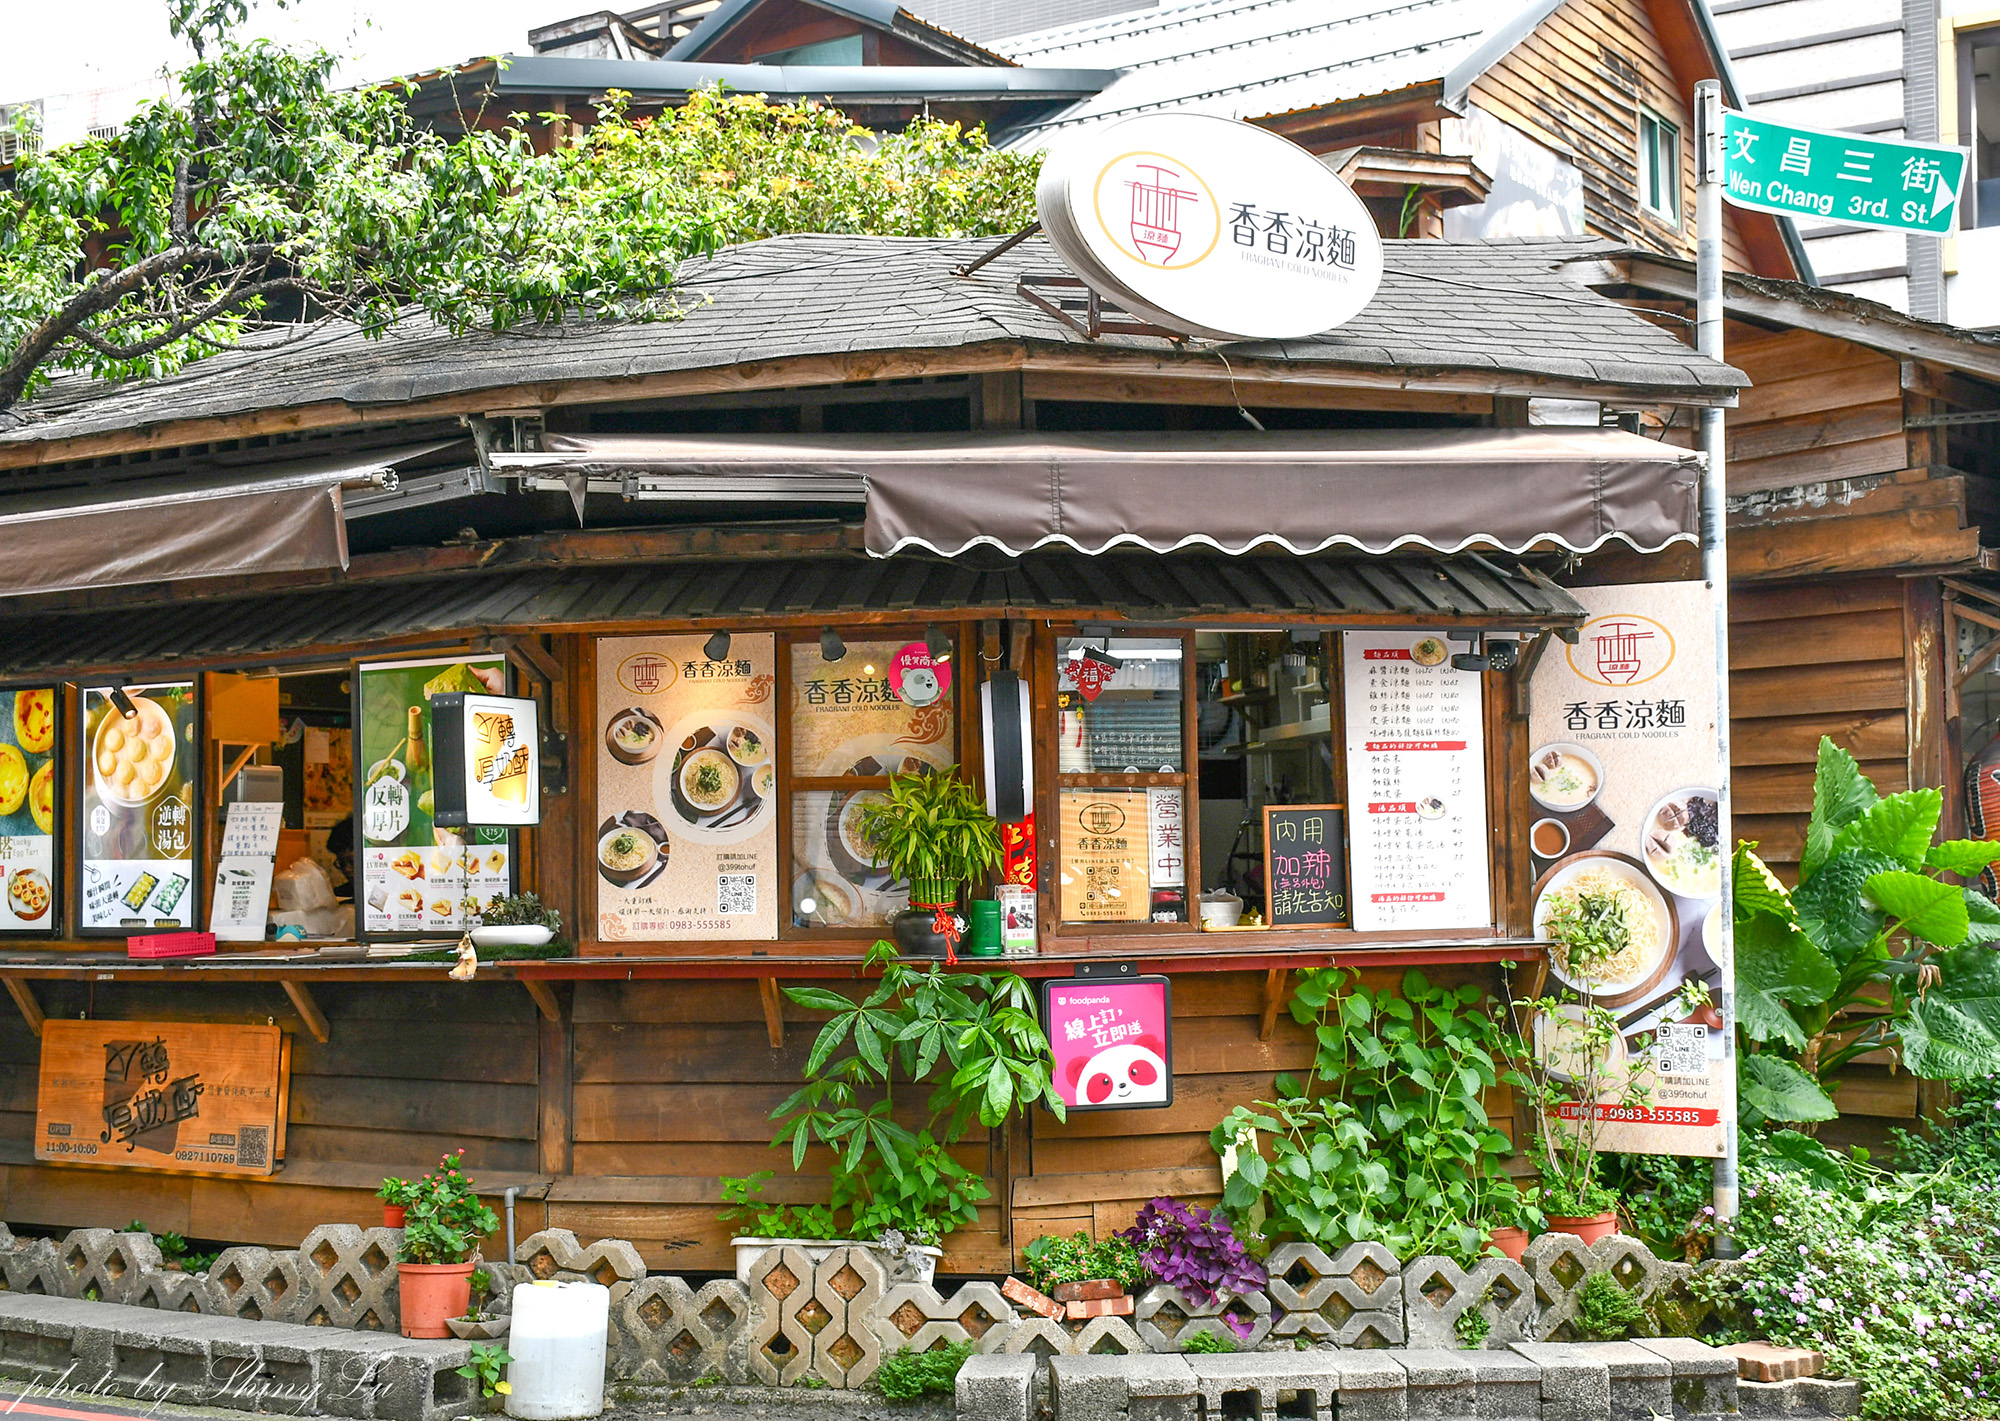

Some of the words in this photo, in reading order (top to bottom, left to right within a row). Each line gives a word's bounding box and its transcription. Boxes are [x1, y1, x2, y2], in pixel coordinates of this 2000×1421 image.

[1731, 127, 1941, 194] 文昌三街
[1730, 170, 1761, 199] Wen
[1766, 181, 1834, 215] Chang
[1848, 196, 1889, 219] 3rd.
[1901, 201, 1930, 224] St.
[1143, 229, 1168, 244] 涼麵
[1229, 202, 1356, 271] 香香涼麵
[1241, 251, 1285, 269] FRAGRANT
[1287, 261, 1310, 275] COLD
[1312, 267, 1348, 284] NOODLES
[682, 659, 751, 678] 香香涼麵
[1082, 667, 1098, 682] 福
[1608, 663, 1630, 671] 涼麵
[816, 705, 850, 713] FRAGRANT
[1563, 700, 1686, 731] 香香涼麵
[1575, 732, 1616, 740] FRAGRANT
[1618, 731, 1640, 739] COLD
[1641, 730, 1679, 738] NOODLES
[372, 784, 403, 806] 反轉
[158, 805, 187, 826] 逆轉
[372, 810, 403, 832] 厚片
[158, 829, 186, 850] 湯包
[486, 828, 498, 836] $75
[1155, 794, 1181, 878] 營業中
[1078, 837, 1128, 850] 香香涼麵
[13, 848, 24, 858] Egg
[26, 848, 39, 856] Tart
[718, 863, 756, 872] @399tohuf
[1274, 848, 1331, 878] 加辣
[1273, 889, 1343, 915] 請先告知
[1069, 995, 1110, 1006] foodpanda
[1091, 1020, 1143, 1048] 立即送
[1658, 1089, 1707, 1099] @399tohuf
[50, 1124, 71, 1134] OPEN
[45, 1141, 98, 1155] 11:00-10:00
[175, 1151, 235, 1164] 0927110789
